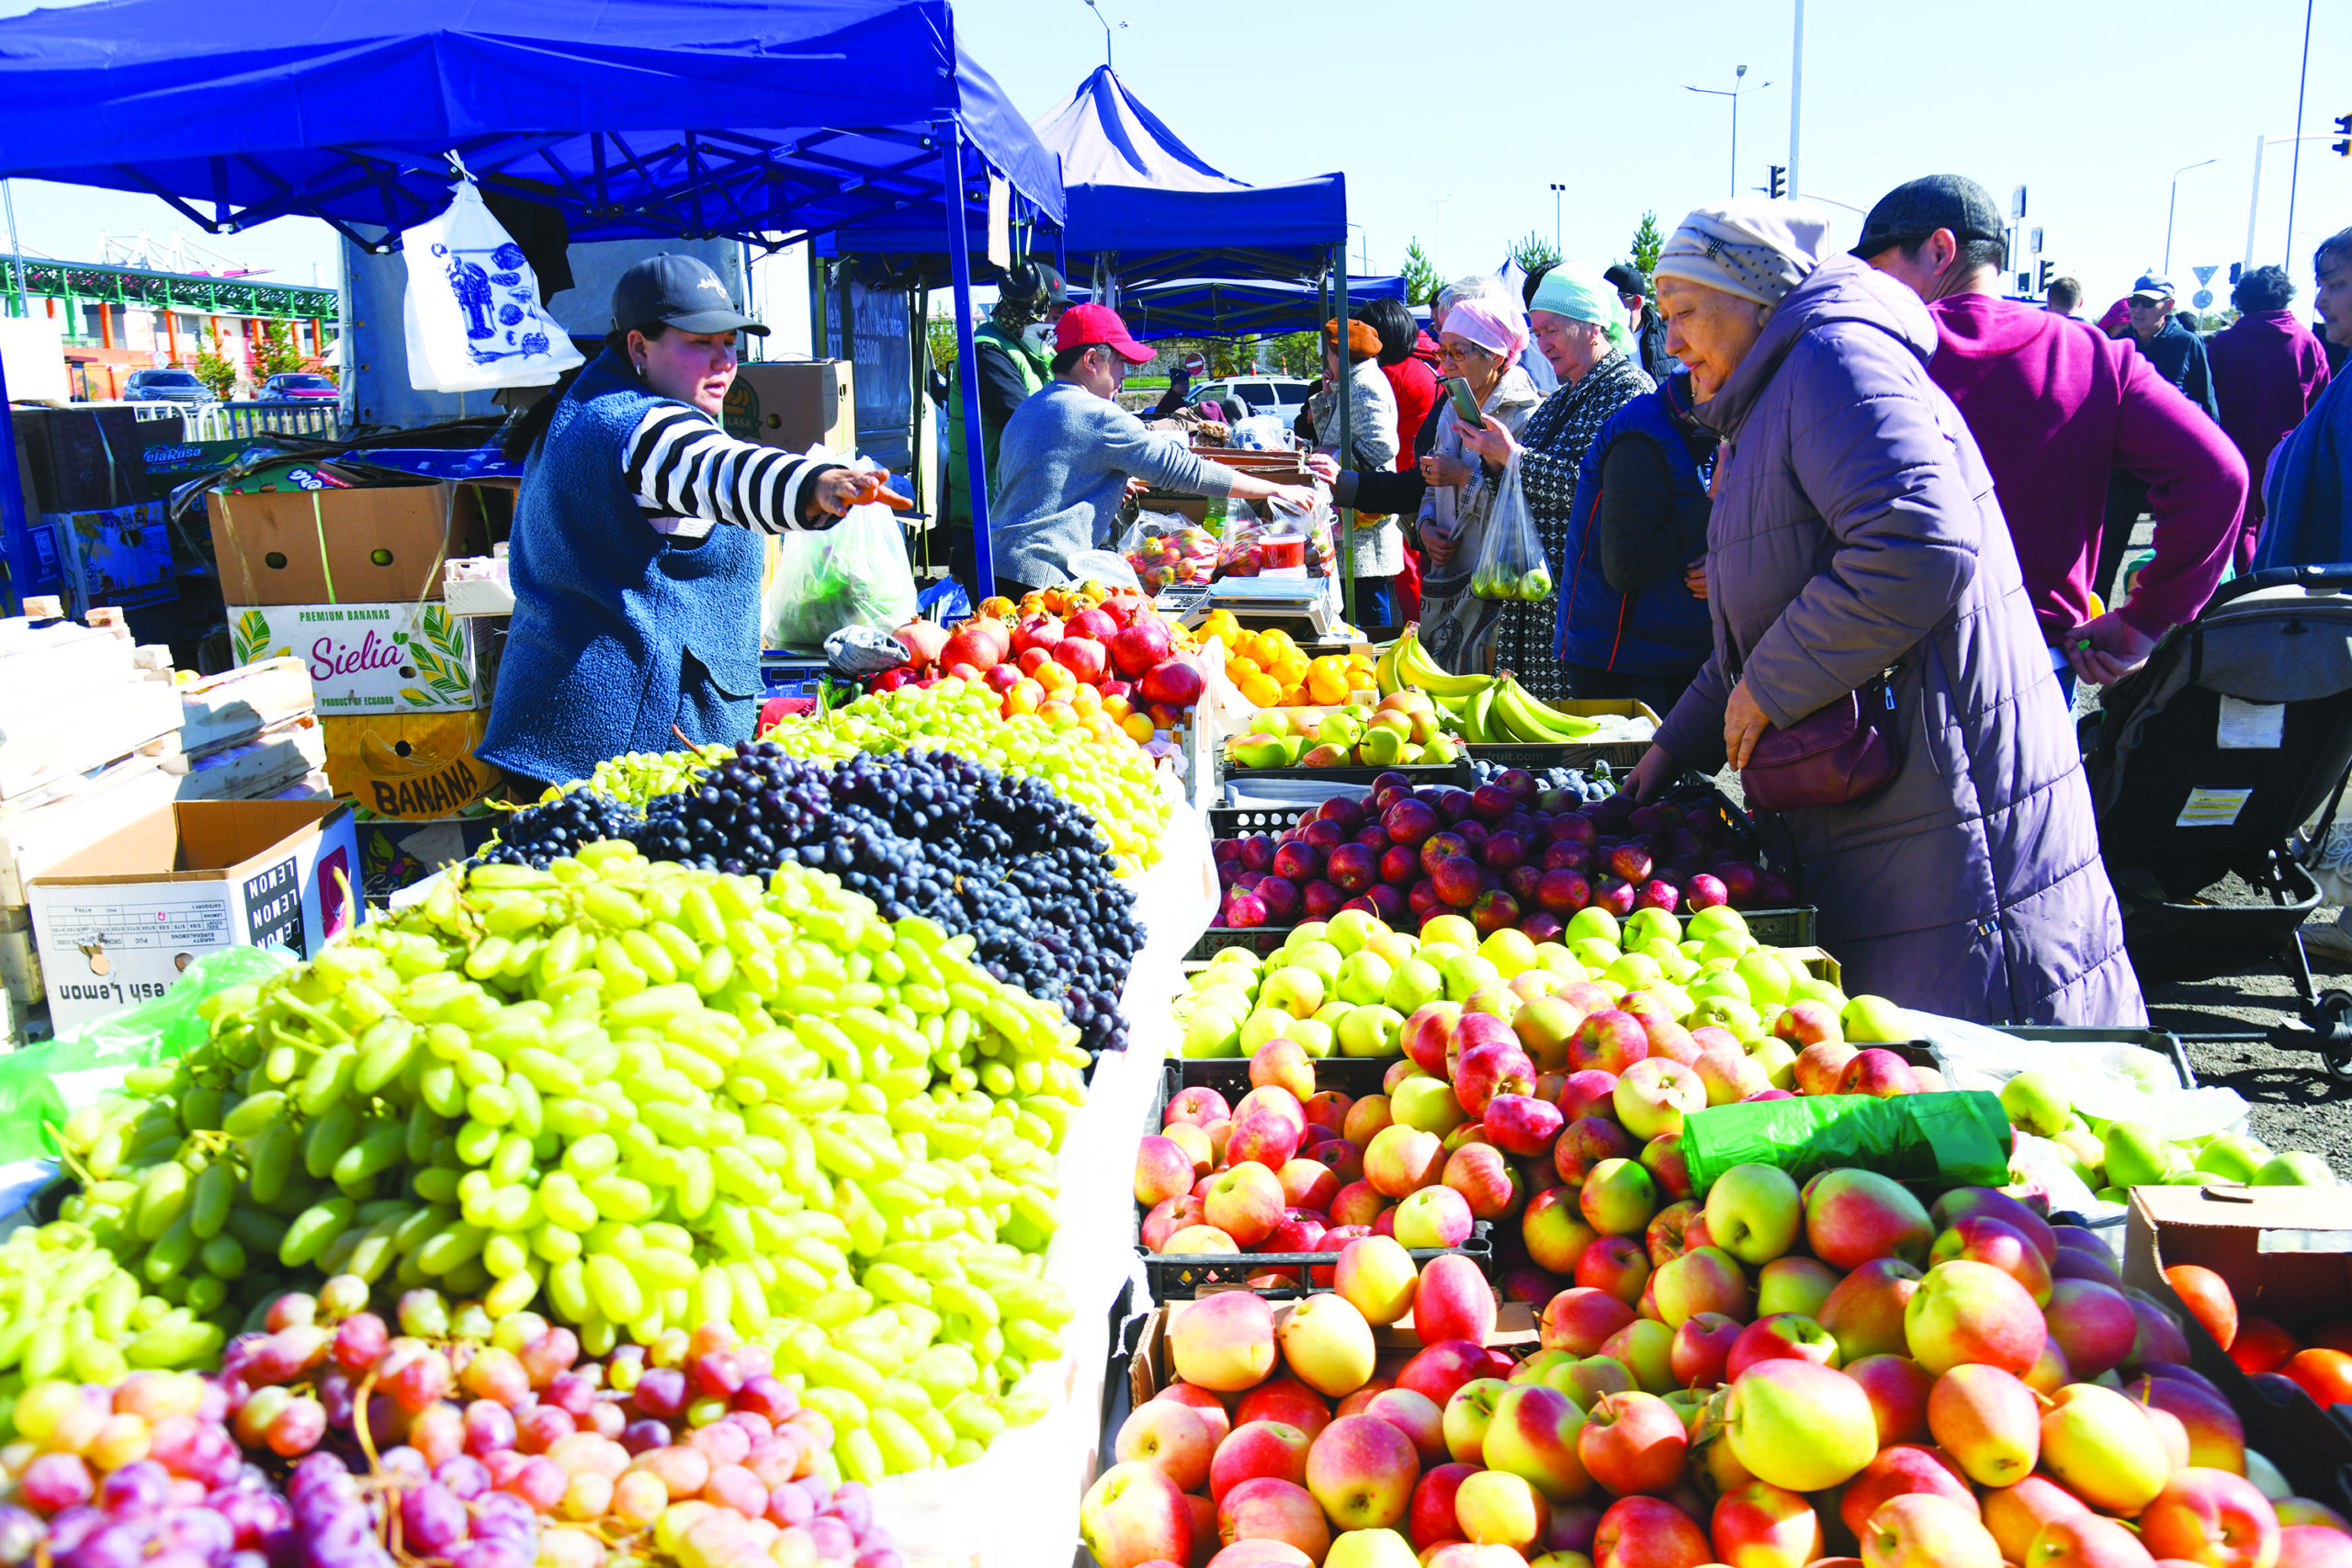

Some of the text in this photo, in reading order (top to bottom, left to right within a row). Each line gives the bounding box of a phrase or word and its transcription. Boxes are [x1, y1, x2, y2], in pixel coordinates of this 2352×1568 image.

[299, 609, 390, 622] PREMIUM BANANAS
[310, 629, 404, 682] Sielia
[322, 696, 394, 706] PRODUCT OF ECUADOR
[370, 759, 478, 816] BANANA
[249, 860, 294, 899] LEMON
[253, 889, 298, 929] LEMON
[256, 918, 300, 952] LEMON
[60, 983, 165, 1004] esh Lemon
